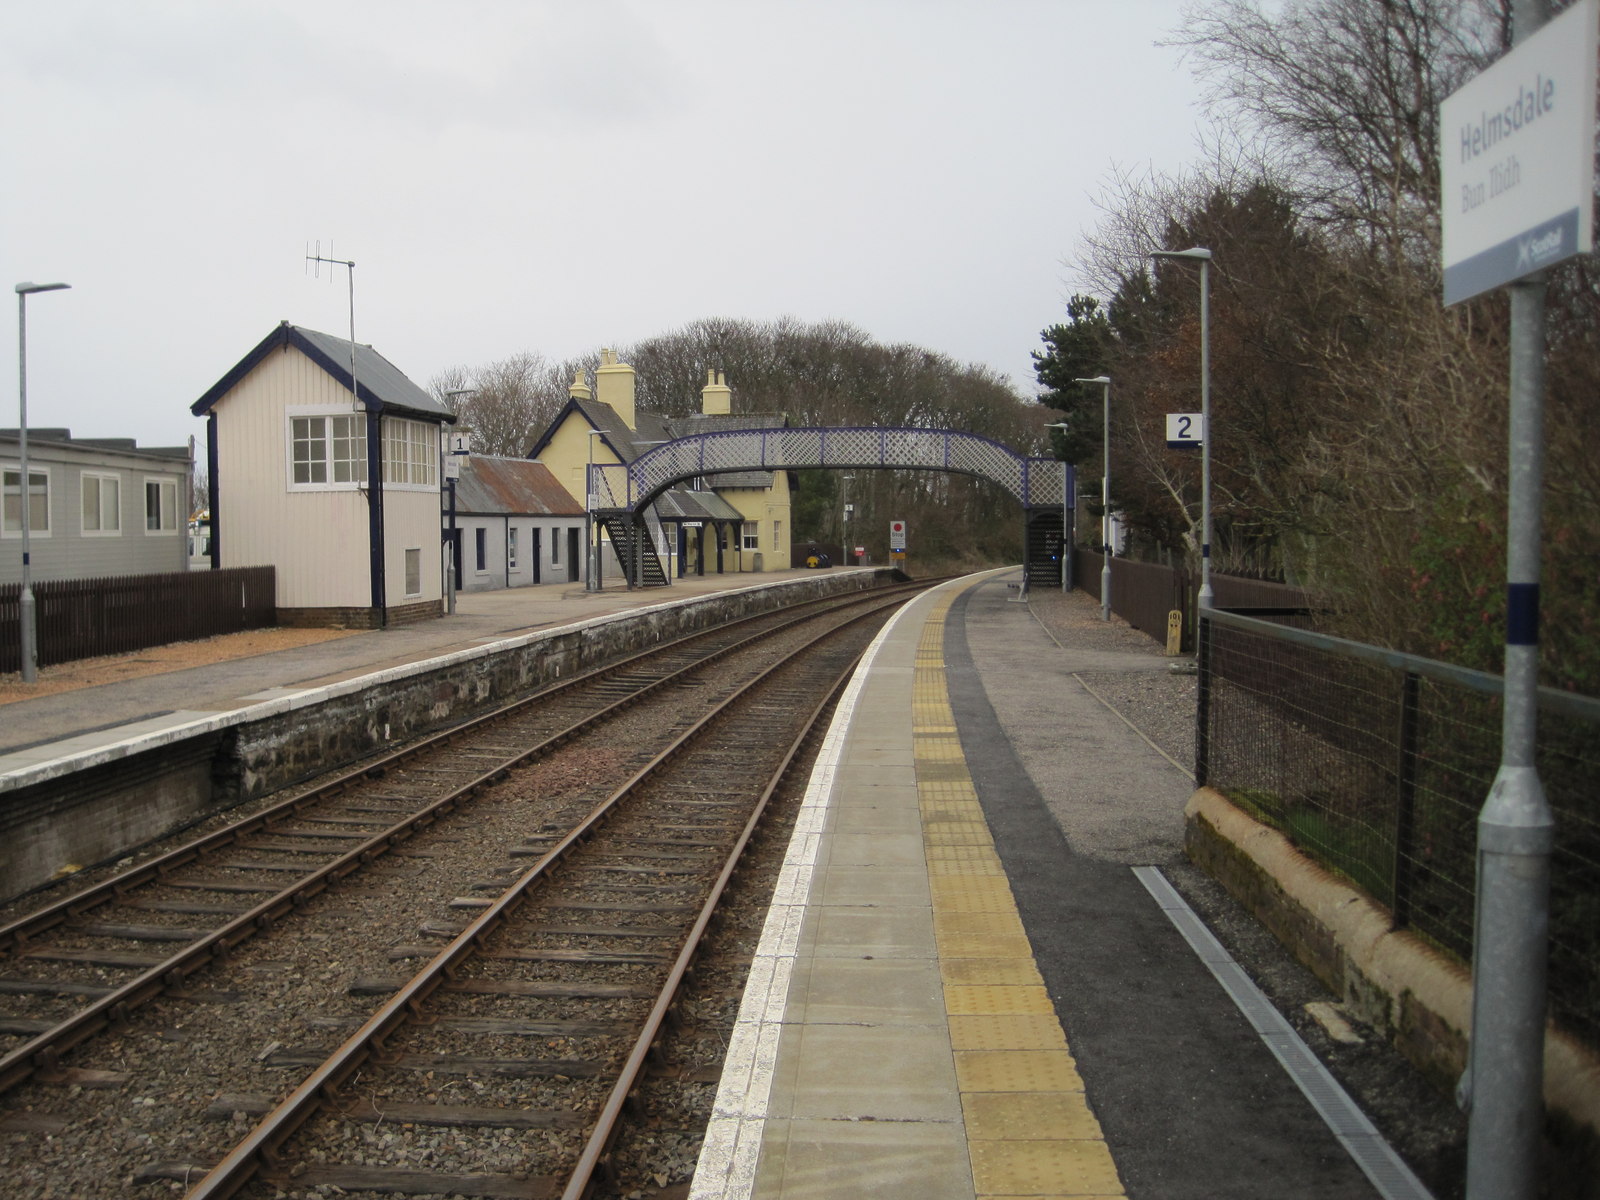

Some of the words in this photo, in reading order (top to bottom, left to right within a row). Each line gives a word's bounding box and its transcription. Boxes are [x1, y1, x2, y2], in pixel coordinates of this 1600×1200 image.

[1460, 73, 1554, 164] Helmsdale
[1461, 183, 1485, 214] Bun
[1178, 416, 1191, 438] 2
[456, 438, 463, 449] 1
